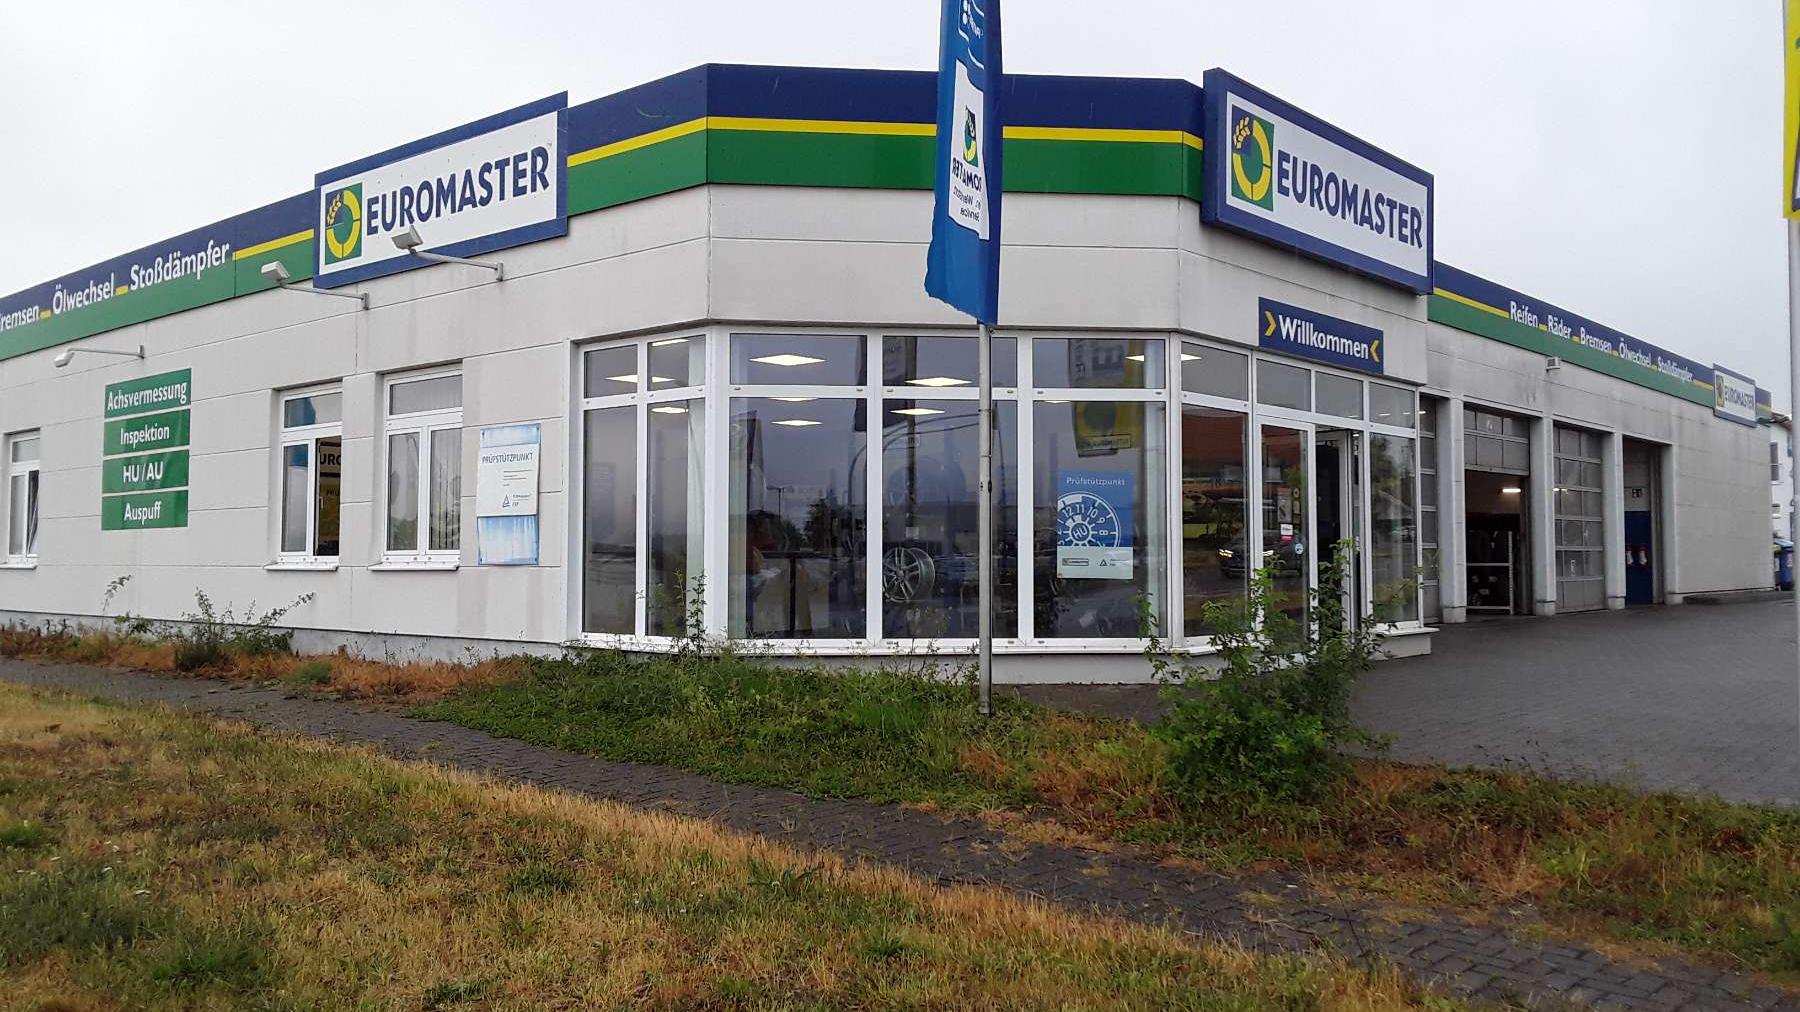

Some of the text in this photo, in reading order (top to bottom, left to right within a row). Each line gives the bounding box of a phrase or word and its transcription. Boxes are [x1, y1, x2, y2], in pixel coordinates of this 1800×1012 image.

[366, 145, 550, 237] EUROMASTER
[1277, 148, 1424, 249] EUROMASTER
[0, 238, 230, 332] remsen Ölwechsel Stoßdämpfer
[1278, 314, 1369, 360] Willkommen
[1510, 300, 1539, 329] Reifen
[1547, 314, 1572, 341] Räder
[1580, 326, 1613, 354] Bremsen
[107, 381, 188, 411] Achsvermessung
[120, 423, 170, 449] Inspektion
[482, 452, 533, 464] PRÜFSTÜTZPUNKT
[1066, 477, 1125, 487] Prüfstützpunkt
[123, 500, 162, 525] Auspuff
[1087, 506, 1099, 518] 10
[1072, 525, 1088, 540] HU
